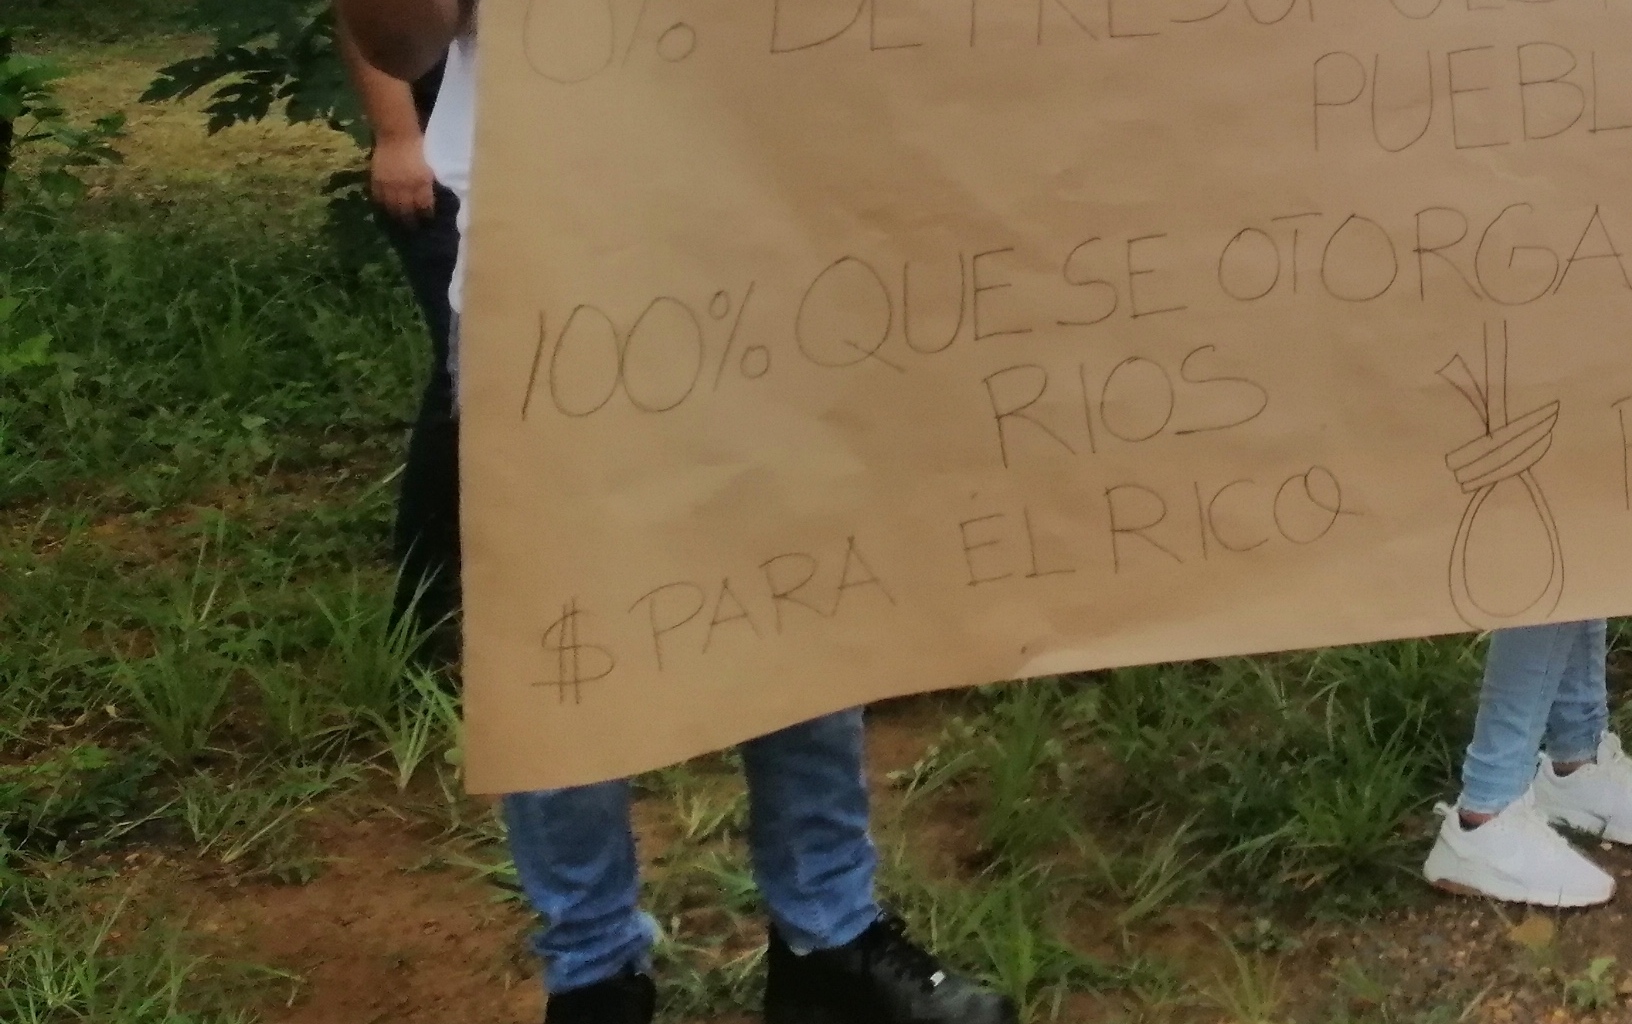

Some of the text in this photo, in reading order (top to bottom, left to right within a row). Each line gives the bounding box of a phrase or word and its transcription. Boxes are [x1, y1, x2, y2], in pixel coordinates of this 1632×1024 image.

[520, 280, 772, 422] 100%
[795, 246, 1034, 374] QUE
[1056, 232, 1189, 329] SE
[983, 342, 1270, 470] RIOS
[531, 595, 616, 707] $
[627, 534, 898, 672] PARA
[1104, 464, 1365, 573] RICO
